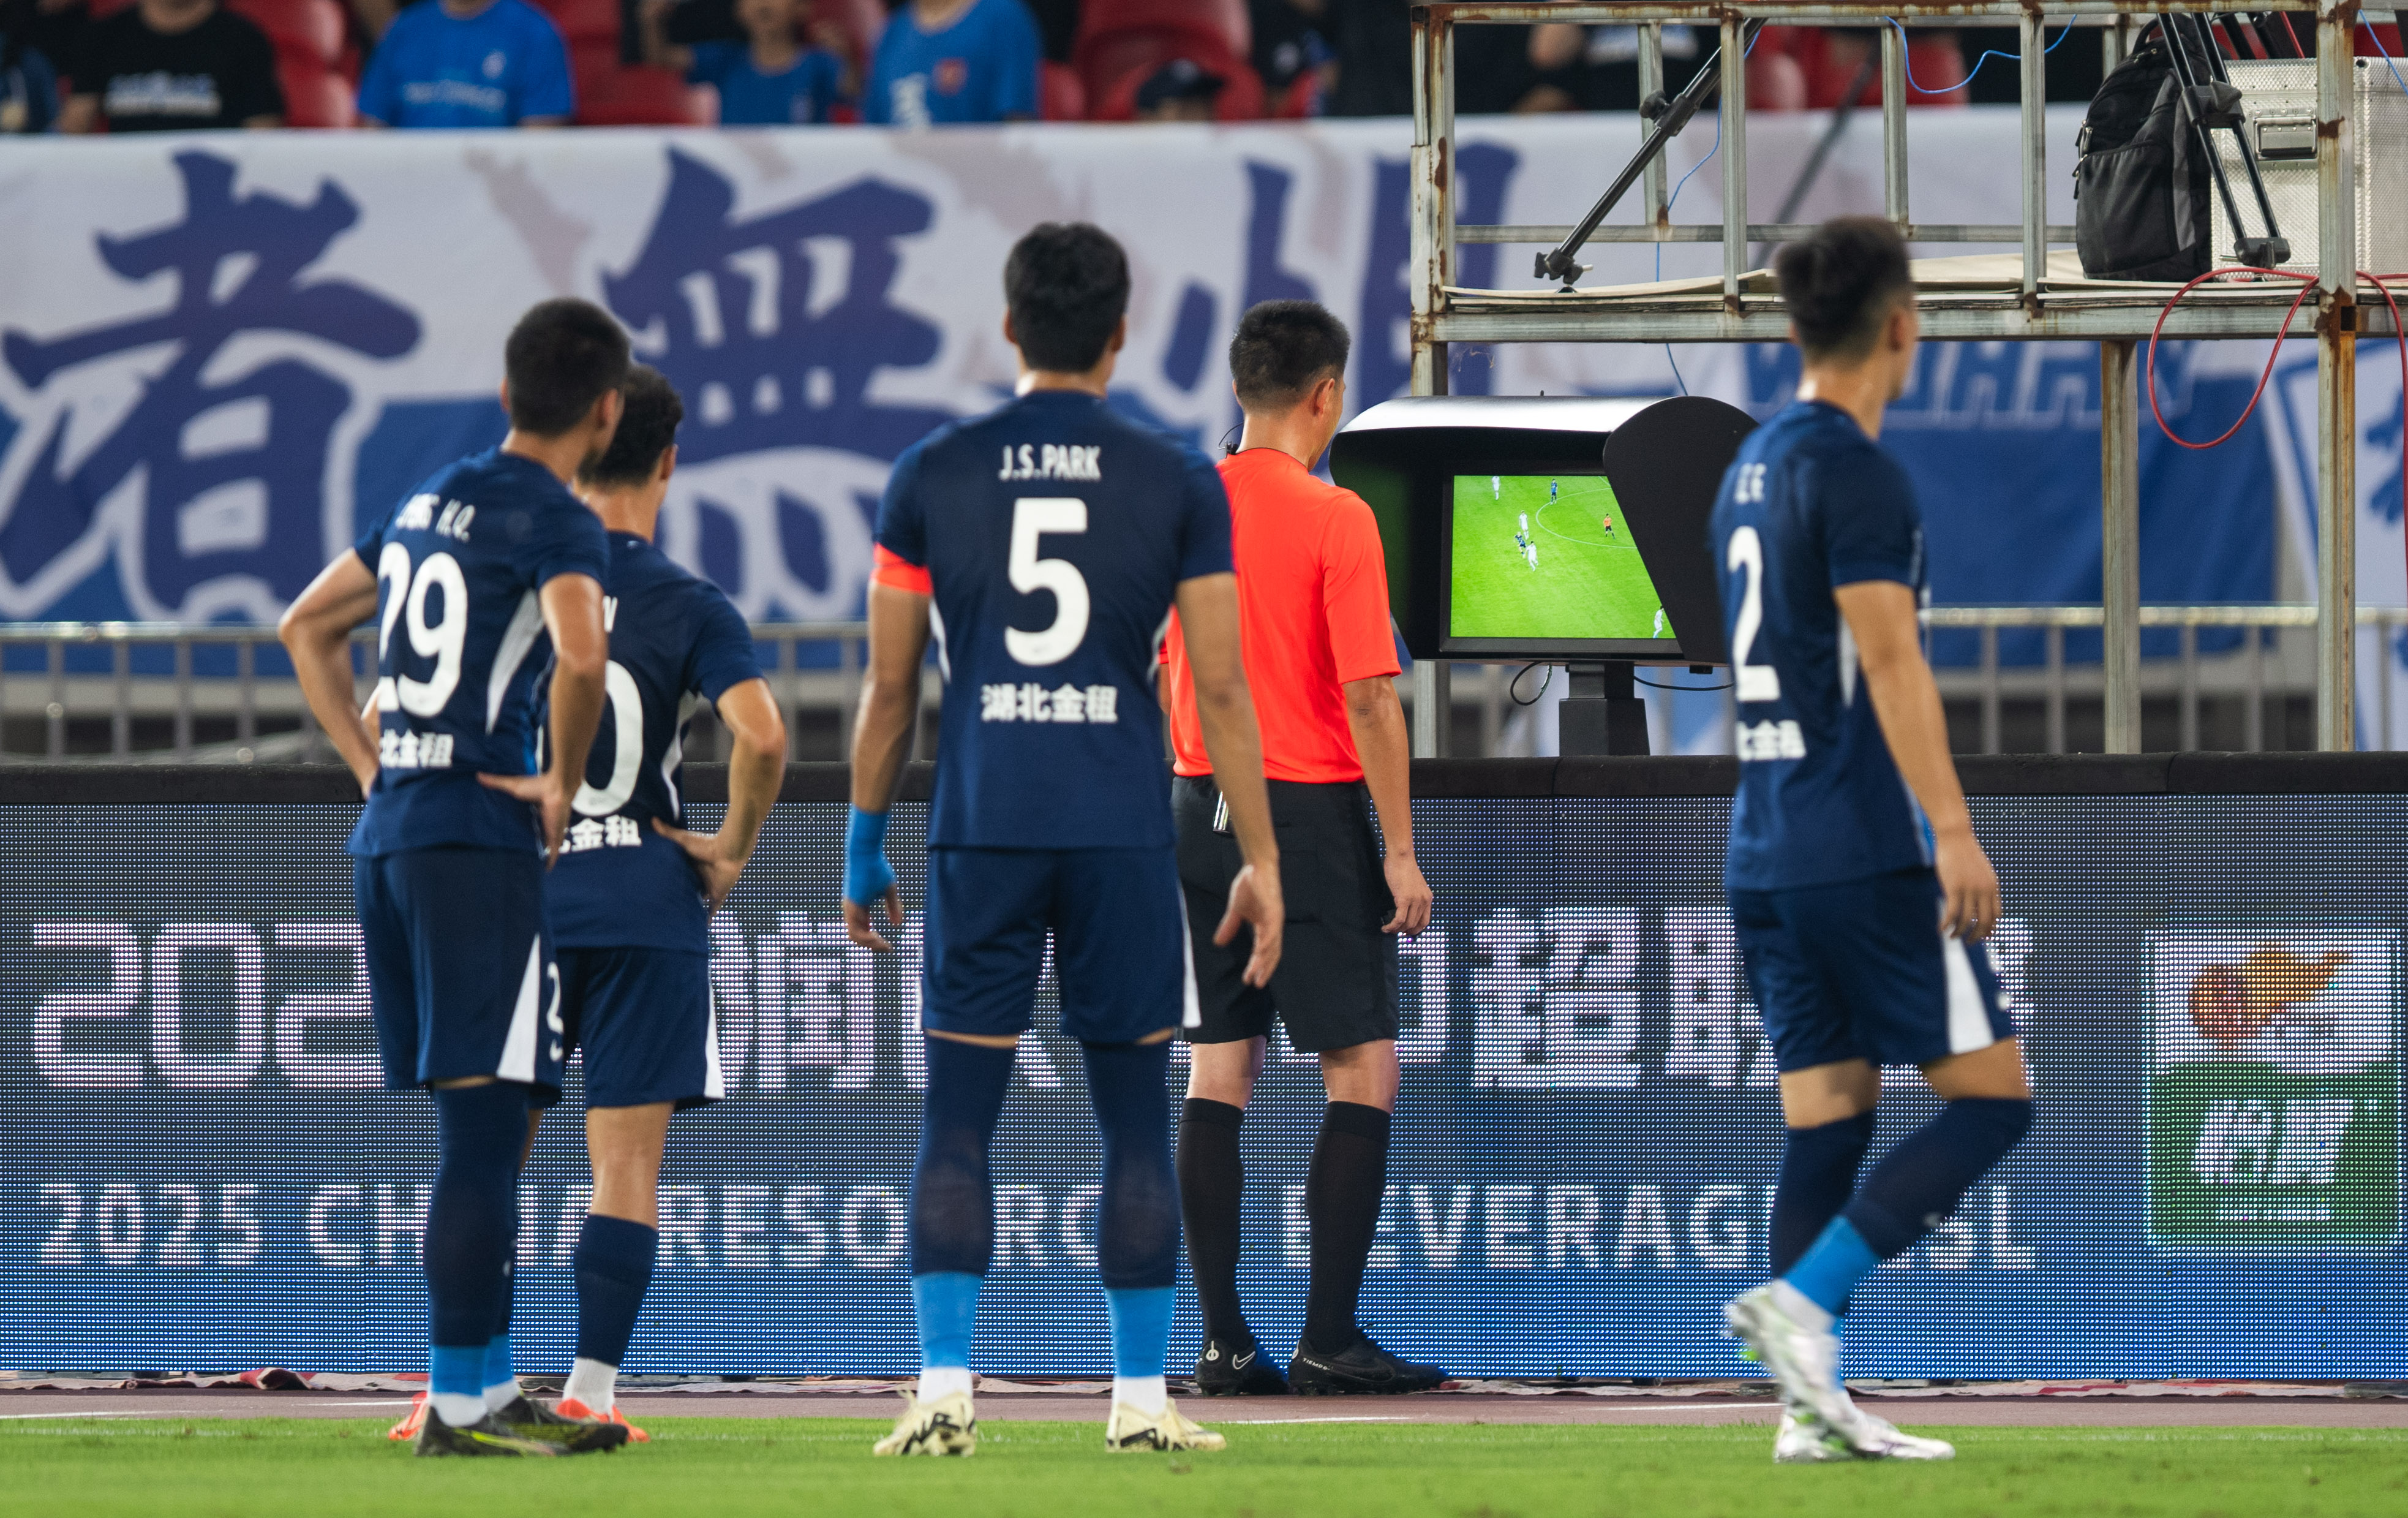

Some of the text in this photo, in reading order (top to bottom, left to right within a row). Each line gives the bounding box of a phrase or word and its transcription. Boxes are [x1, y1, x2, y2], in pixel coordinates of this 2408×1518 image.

[999, 444, 1102, 481] J.S.PARK
[378, 542, 468, 718] 29
[1004, 497, 1090, 666] 5
[1727, 525, 1781, 701] 2
[981, 682, 1118, 723] 湖北金租
[40, 1182, 260, 1265] 2025
[1282, 1184, 1777, 1267] BEVERAG
[1873, 1185, 2036, 1269] SL
